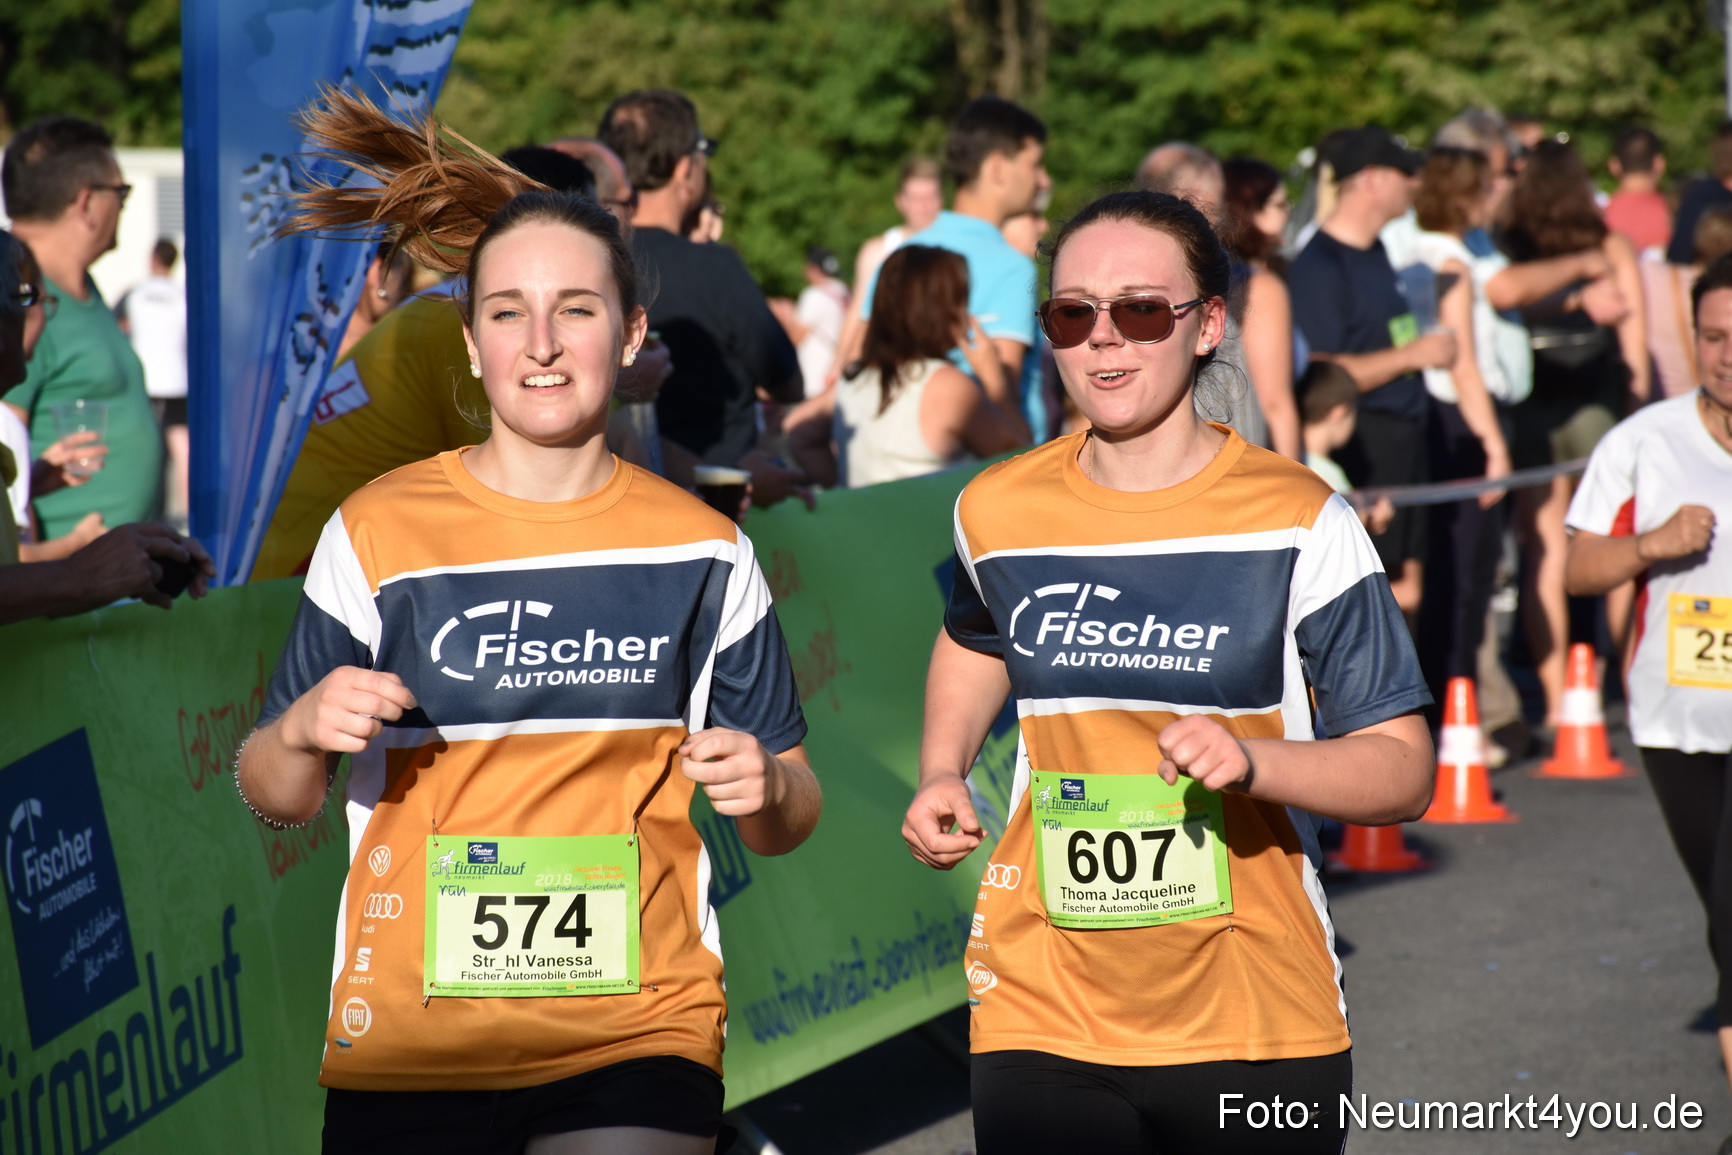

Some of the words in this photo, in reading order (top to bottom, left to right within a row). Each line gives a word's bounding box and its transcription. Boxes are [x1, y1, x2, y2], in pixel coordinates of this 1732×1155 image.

[1036, 612, 1230, 651] Fischer
[475, 629, 669, 668] Fischer
[1051, 652, 1212, 673] AUTOMOBILE
[494, 668, 657, 689] AUTOMOBILE
[1051, 796, 1109, 812] firmenlauf
[1119, 810, 1155, 822] 2018
[22, 826, 93, 897] Fischer
[1067, 828, 1177, 884] 607
[454, 861, 526, 875] firmenlauf
[535, 873, 573, 887] 2018
[38, 872, 98, 922] AUTOMOBILE
[1060, 886, 1107, 901] Thoma
[1112, 882, 1196, 902] Jacqueline
[1062, 902, 1096, 913] Fischer
[1099, 901, 1159, 913] Automobile
[1162, 896, 1195, 910] GmbH
[472, 893, 593, 950] 574
[967, 939, 990, 951] SEAT
[471, 954, 520, 971] Str_hl
[525, 954, 593, 968] Vanessa
[347, 976, 375, 985] SEAT
[461, 970, 502, 981] Fischer
[504, 969, 567, 981] Automobile
[570, 969, 603, 979] GmbH
[348, 1008, 365, 1026] FIAT
